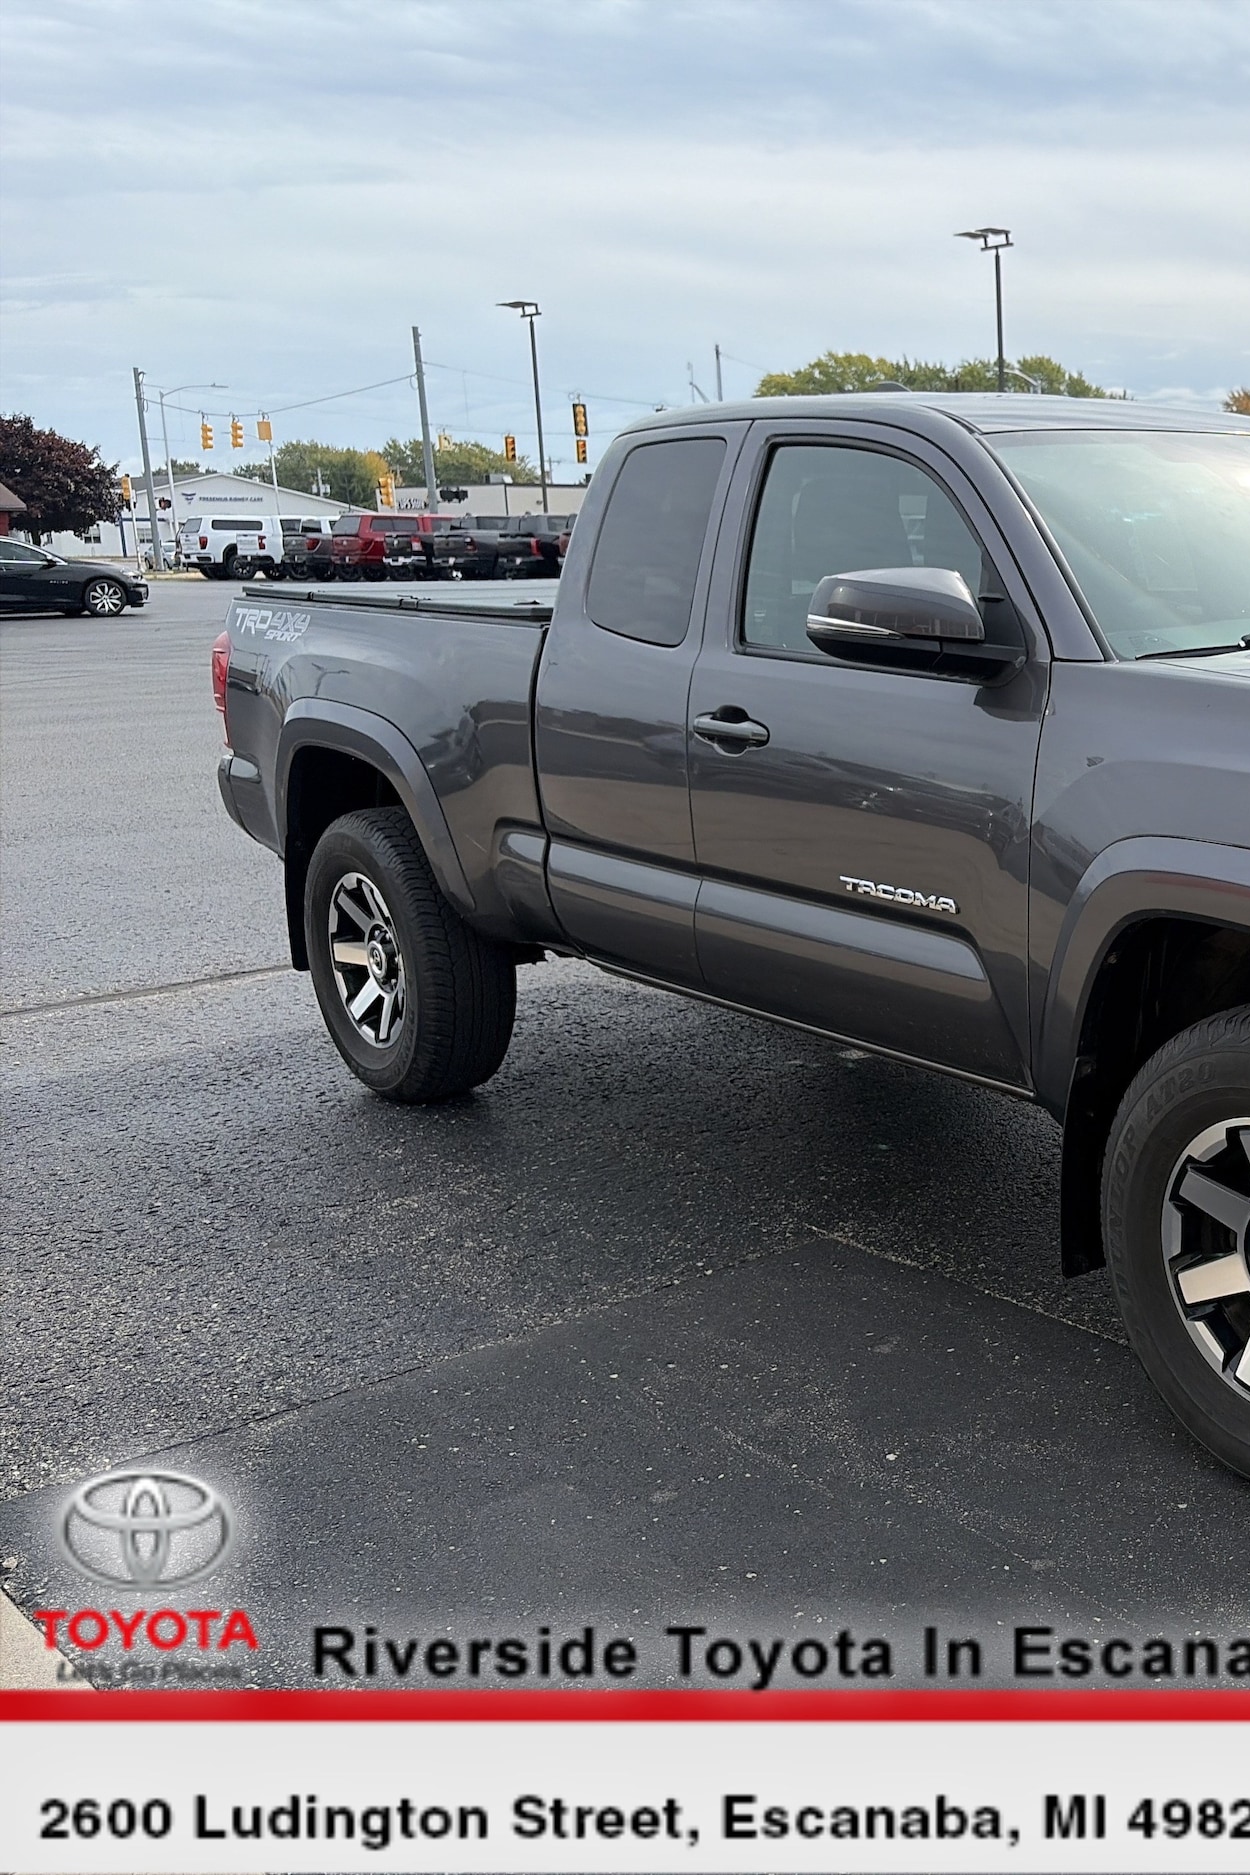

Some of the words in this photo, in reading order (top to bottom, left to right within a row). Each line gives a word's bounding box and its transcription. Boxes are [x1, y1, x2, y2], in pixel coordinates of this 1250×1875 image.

[235, 607, 273, 635] TRD
[263, 628, 302, 642] SPORT
[839, 875, 959, 914] TACOMA
